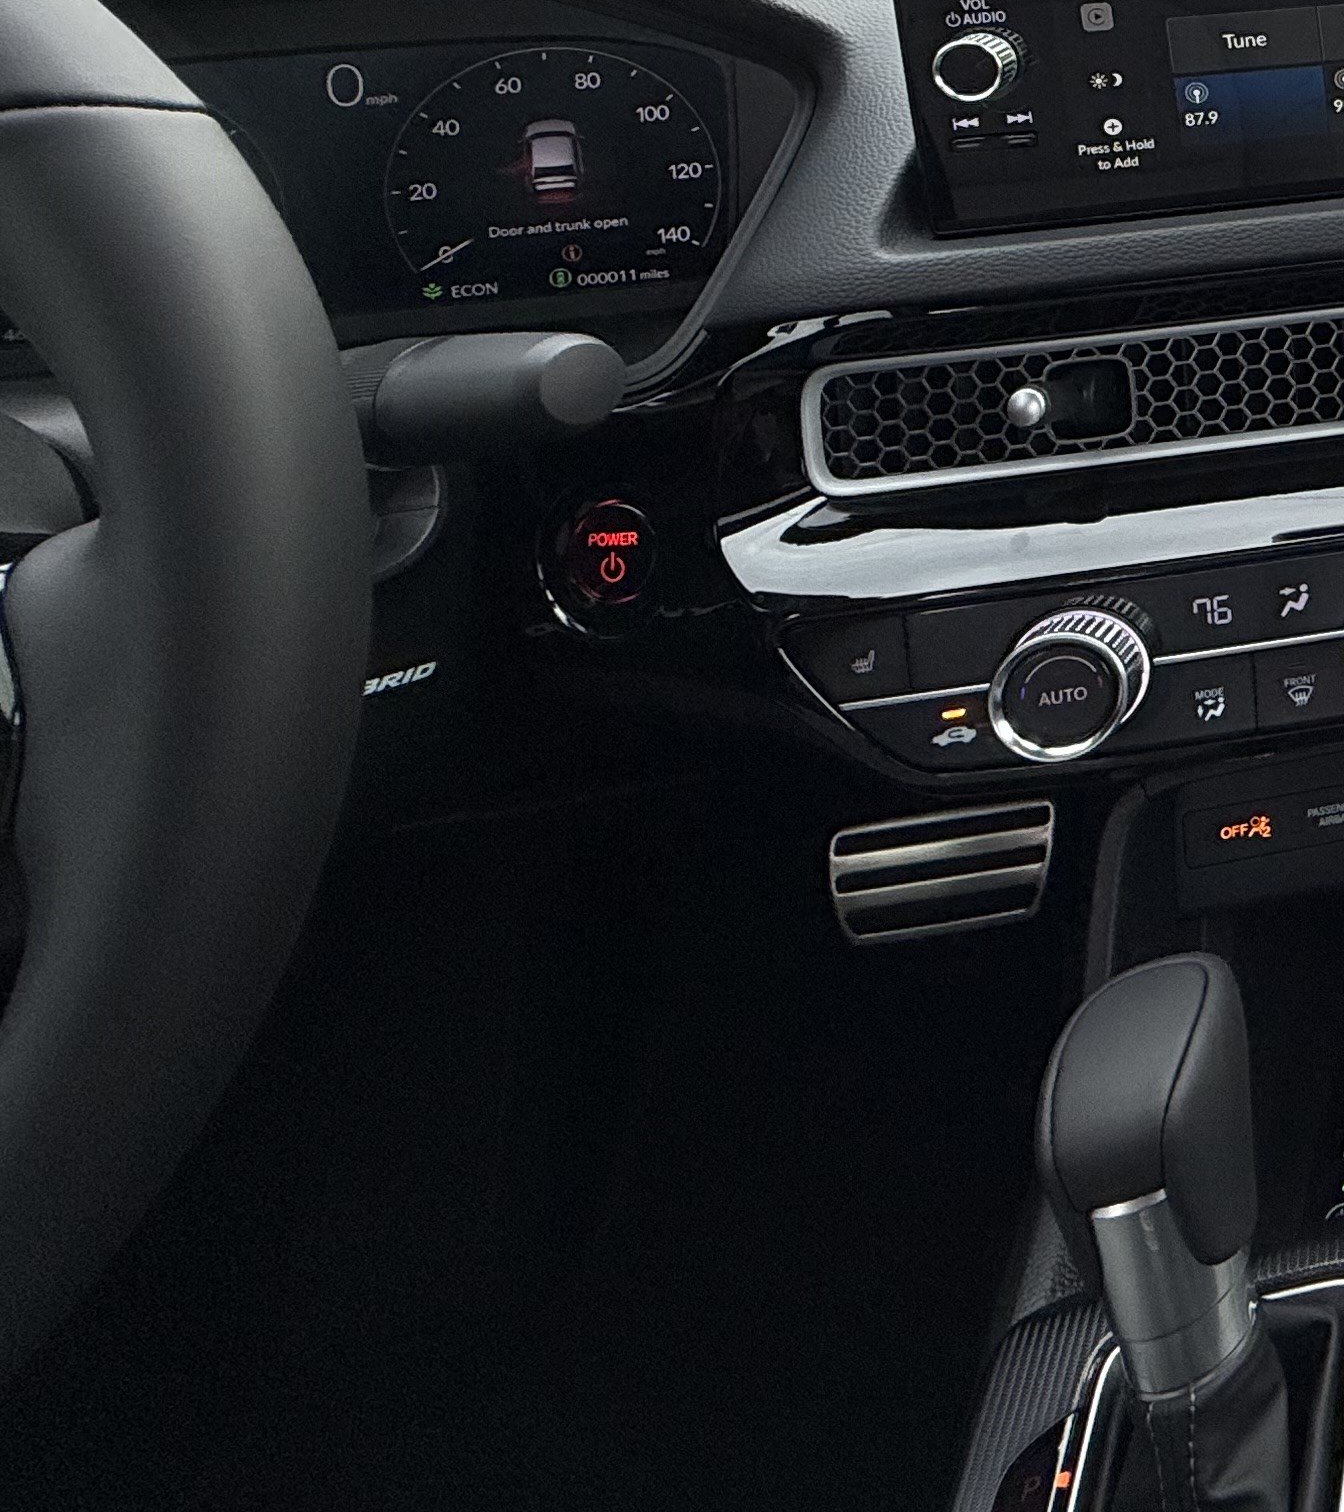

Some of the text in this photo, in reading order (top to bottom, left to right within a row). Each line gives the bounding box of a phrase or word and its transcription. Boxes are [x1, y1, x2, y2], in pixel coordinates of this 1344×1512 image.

[963, 11, 1006, 24] AUDIO
[1222, 32, 1268, 50] Tune
[326, 64, 398, 107] 0 mph
[495, 77, 521, 94] 60
[575, 72, 601, 88] 80
[636, 105, 669, 123] 100
[1185, 111, 1218, 126] 87.9
[432, 119, 460, 137] 40
[1078, 138, 1155, 156] Press & Hold
[668, 162, 702, 179] 120
[1098, 155, 1139, 170] to Add
[408, 183, 437, 201] 20
[488, 216, 629, 239] Door and trunk open
[657, 227, 690, 243] 140
[577, 267, 670, 286] 000011 miles
[450, 282, 498, 299] ECON
[588, 532, 638, 547] POWER
[1192, 595, 1233, 626] 76
[1284, 674, 1316, 687] FRONT
[1038, 687, 1088, 707] AUTO
[1195, 686, 1225, 700] MODE
[1220, 823, 1249, 840] OFF
